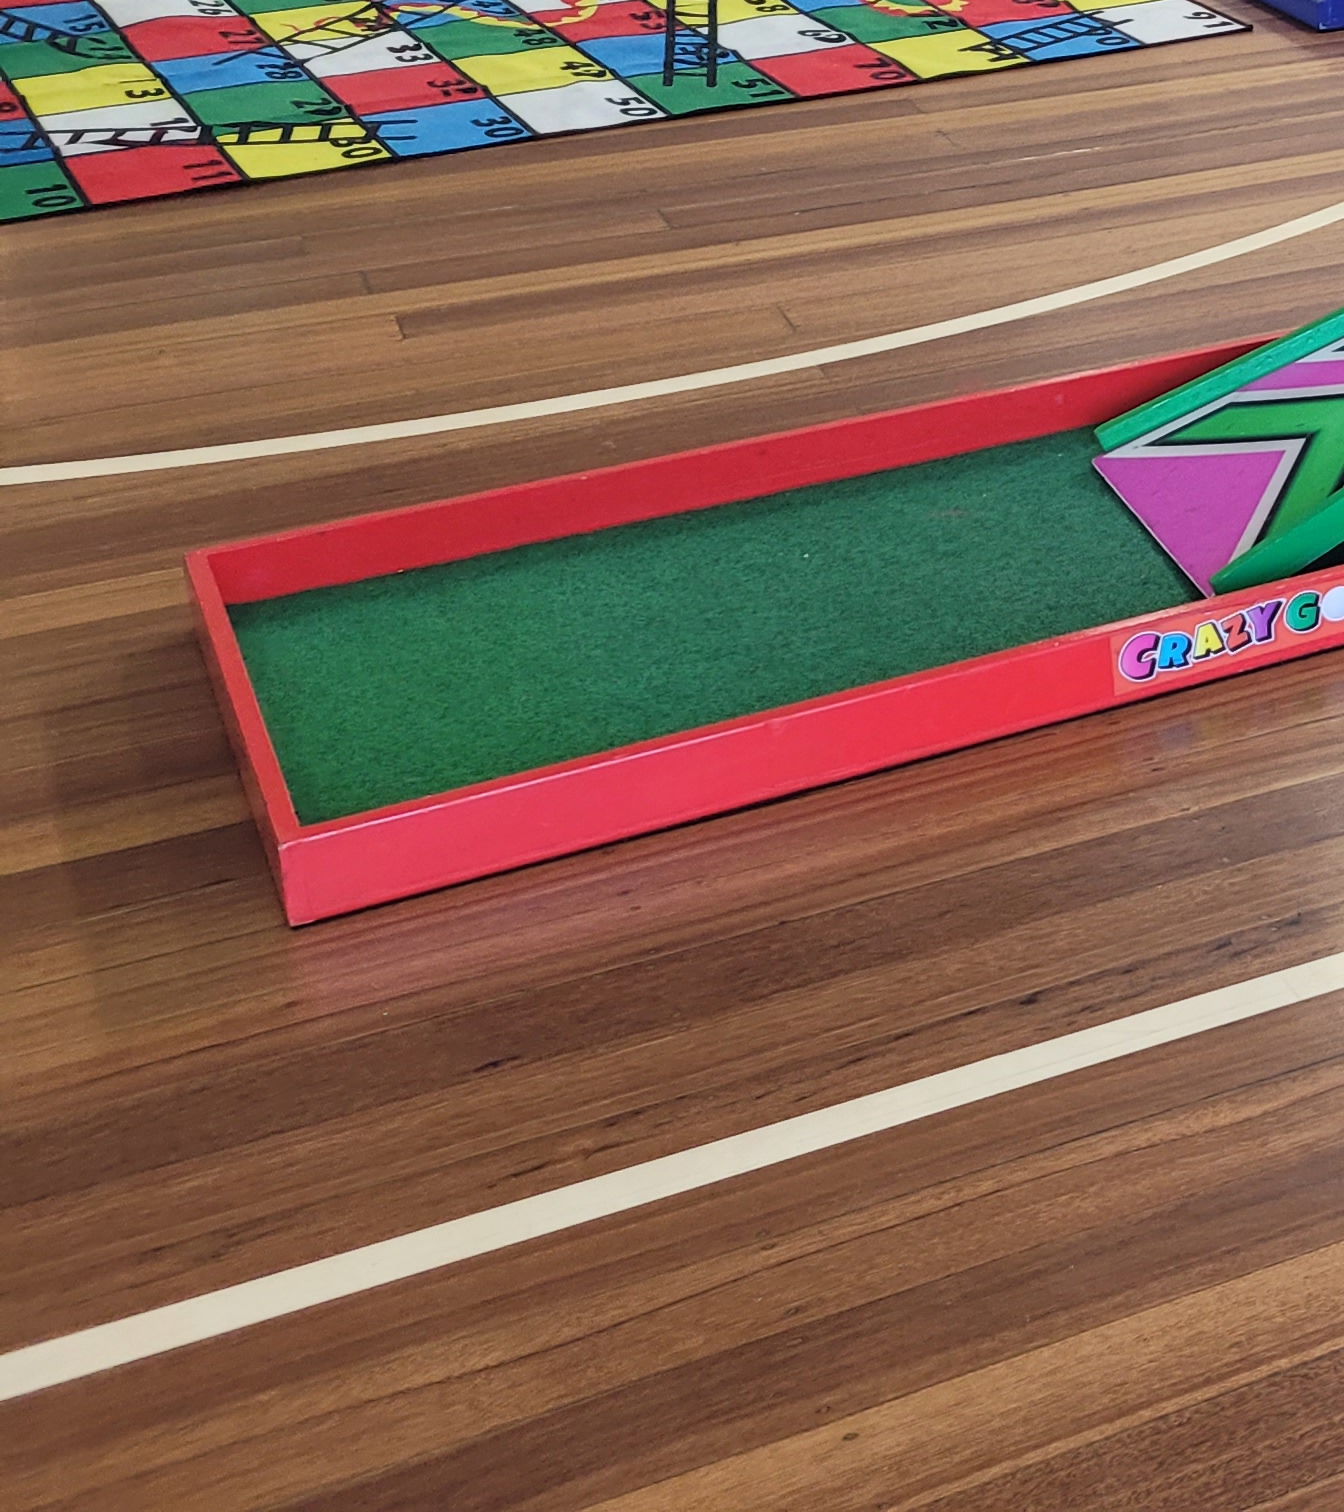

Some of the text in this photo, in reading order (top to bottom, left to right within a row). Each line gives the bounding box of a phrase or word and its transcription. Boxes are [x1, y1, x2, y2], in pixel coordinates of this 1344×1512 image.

[188, 0, 233, 16] 26
[62, 13, 106, 32] 15
[1182, 11, 1234, 29] 91
[513, 28, 558, 46] 48
[387, 42, 434, 63] 33
[853, 58, 905, 80] 70
[731, 78, 786, 98] 51
[604, 96, 658, 117] 50
[470, 116, 525, 138] 30
[24, 184, 77, 208] 10
[1119, 598, 1284, 683] CRAZY
